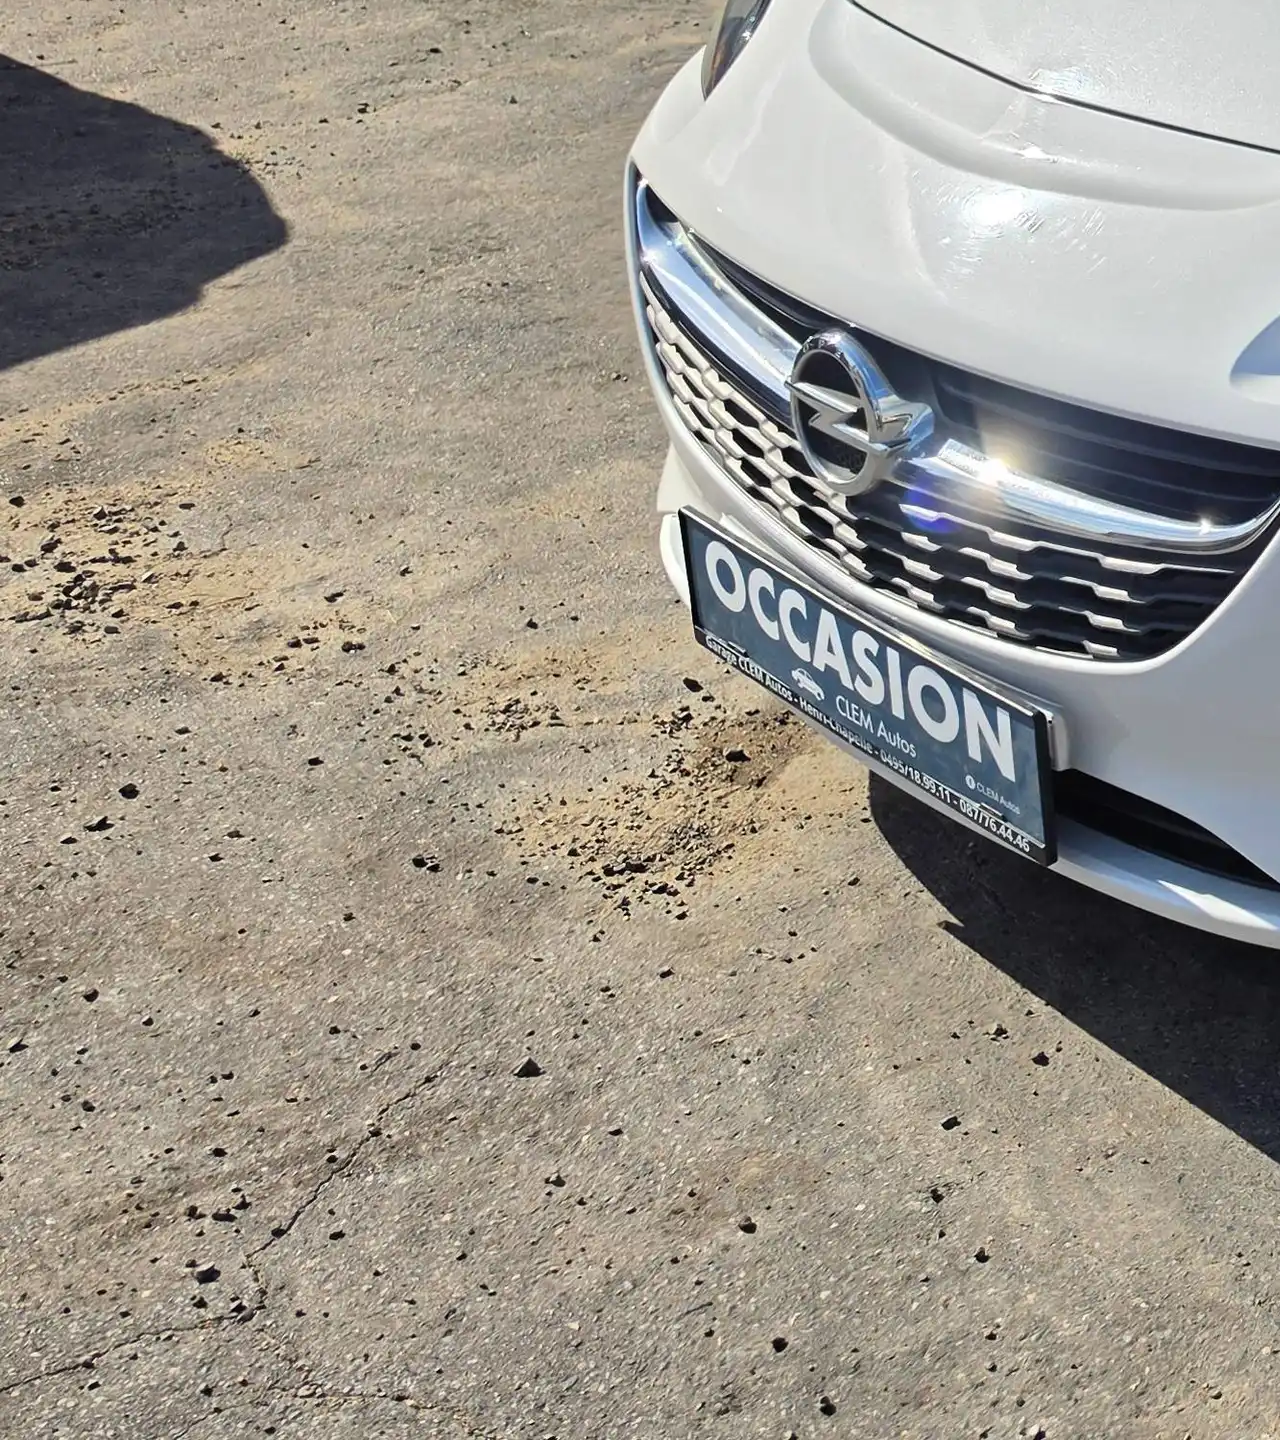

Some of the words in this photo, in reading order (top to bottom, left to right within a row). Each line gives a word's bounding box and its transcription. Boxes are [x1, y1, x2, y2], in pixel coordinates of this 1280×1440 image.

[705, 540, 1016, 782] OCCASION
[738, 656, 764, 683] CLEM
[765, 674, 793, 702] Autos
[880, 749, 951, 804] 0495/18.99.11
[836, 695, 874, 734] CLEM
[877, 720, 917, 758] Autos
[976, 782, 1000, 803] CLEM
